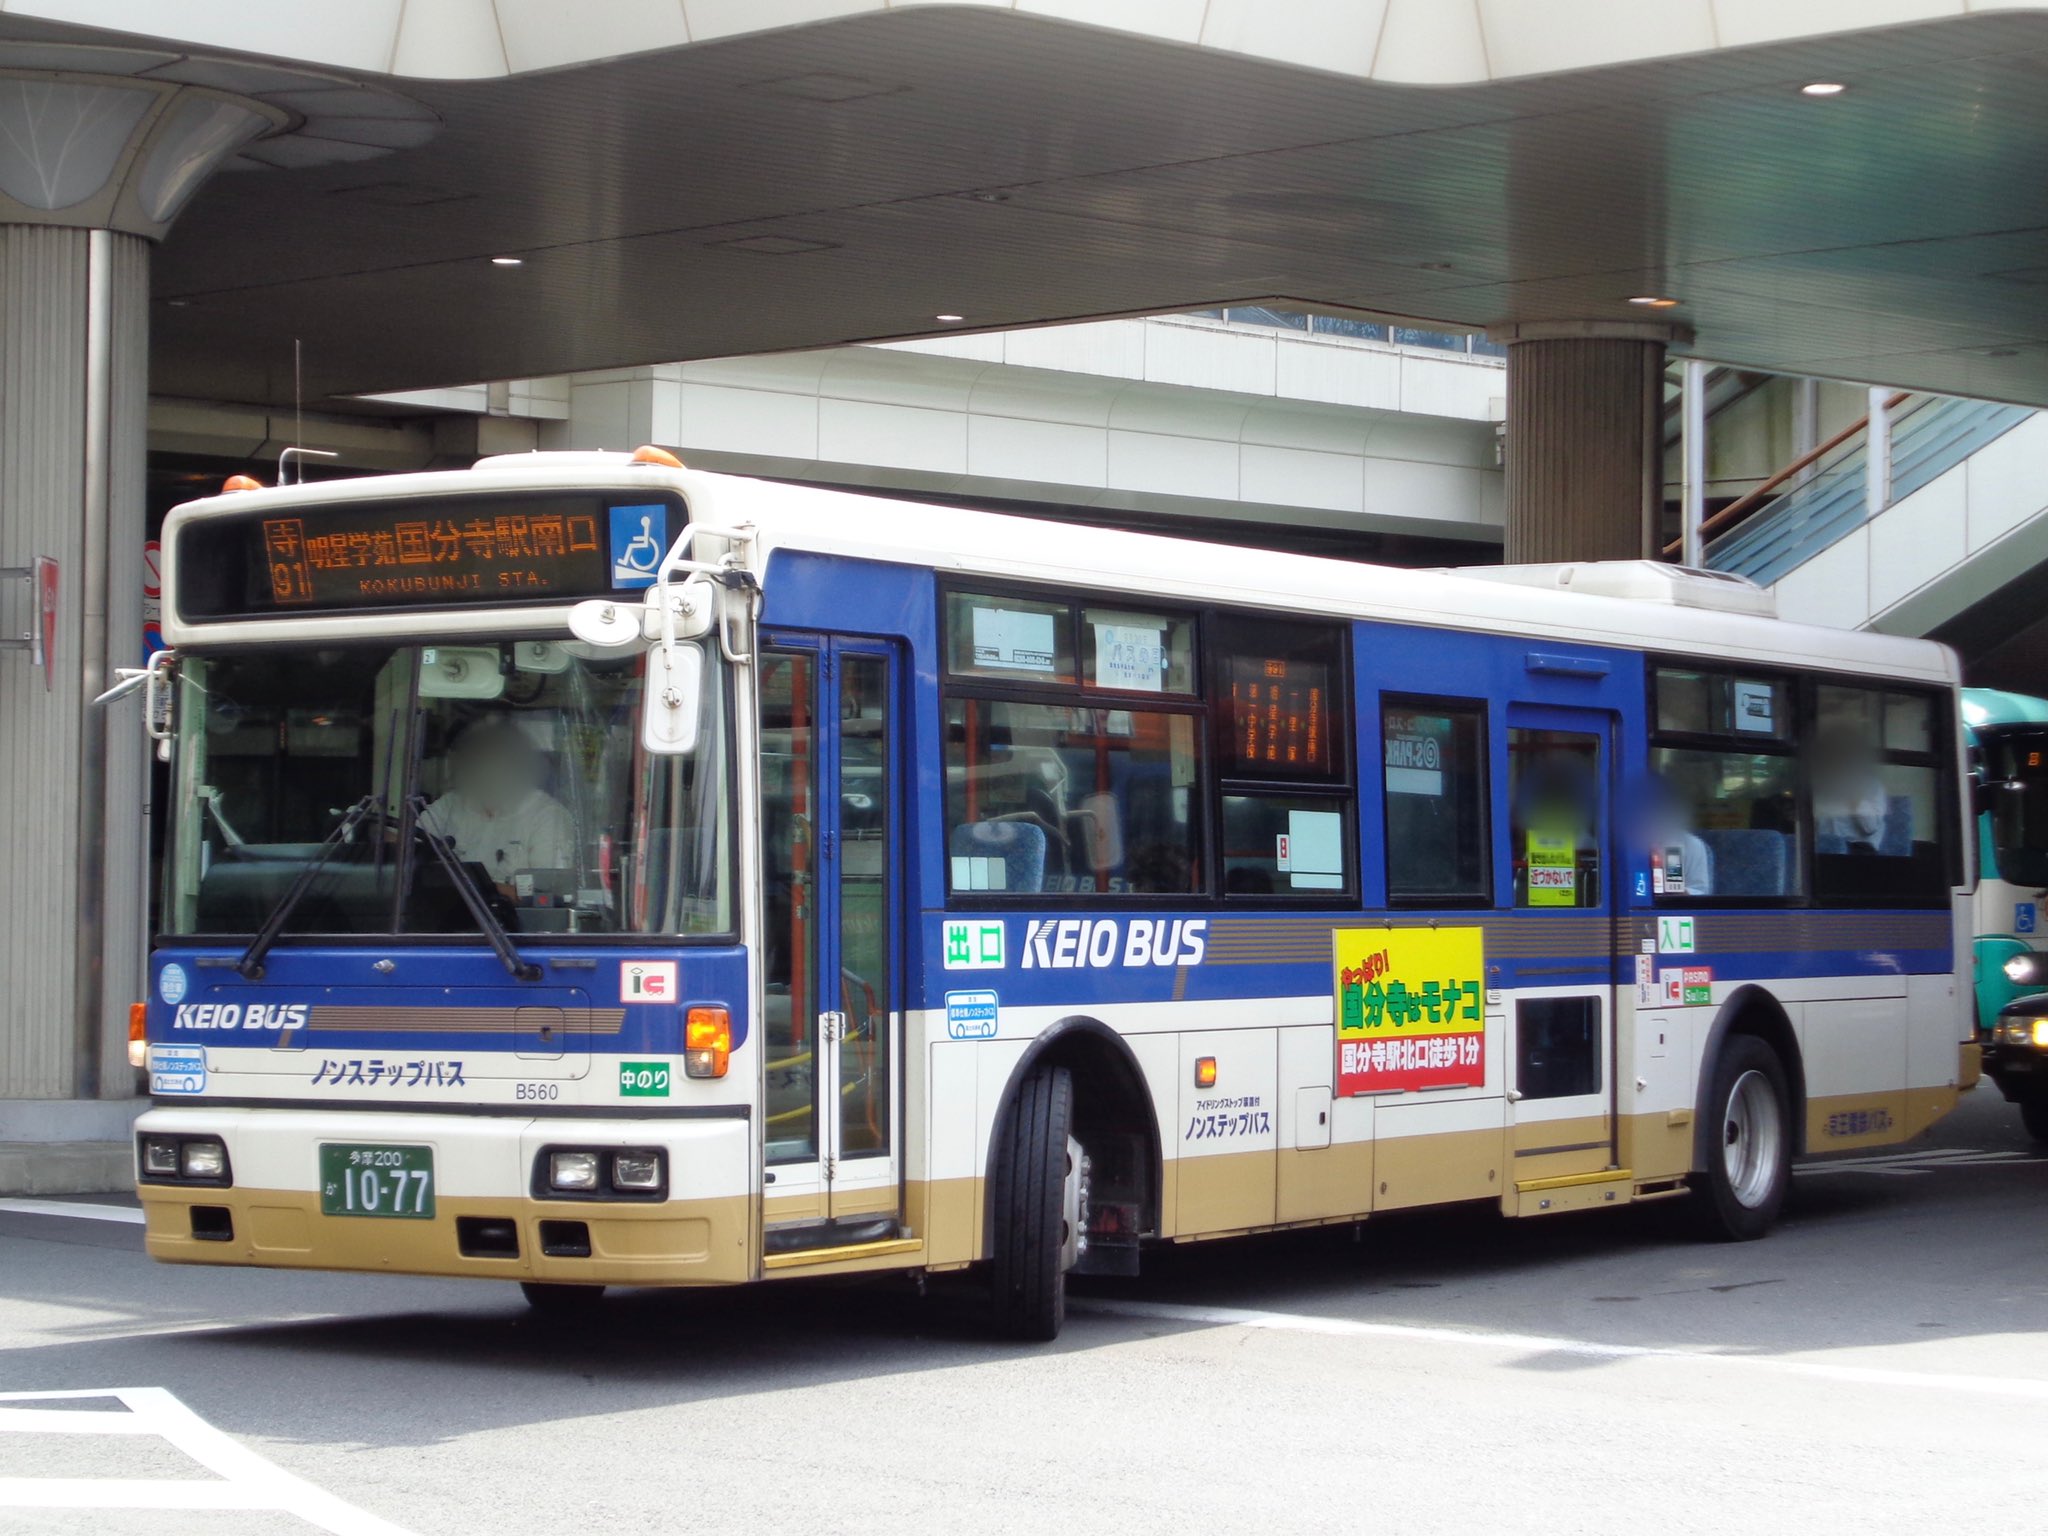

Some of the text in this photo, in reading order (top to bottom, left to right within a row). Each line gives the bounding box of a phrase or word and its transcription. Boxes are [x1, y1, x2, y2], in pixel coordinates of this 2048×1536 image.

[360, 571, 549, 594] KOKUBUNJI STA.
[948, 925, 1001, 964] 出口
[1021, 919, 1207, 968] KEIO BUS
[1661, 920, 1692, 949] 入口
[173, 1004, 308, 1030] KEIO BUS
[1341, 979, 1480, 1030] 国分寺はモナコ
[1341, 1036, 1480, 1075] 国分寺駅北口徒歩1分
[311, 1059, 466, 1088] ノンステップバス
[621, 1068, 668, 1090] 中のり
[516, 1084, 558, 1100] B560
[1185, 1112, 1270, 1140] ノンステップバス
[345, 1168, 429, 1213] 10-77
